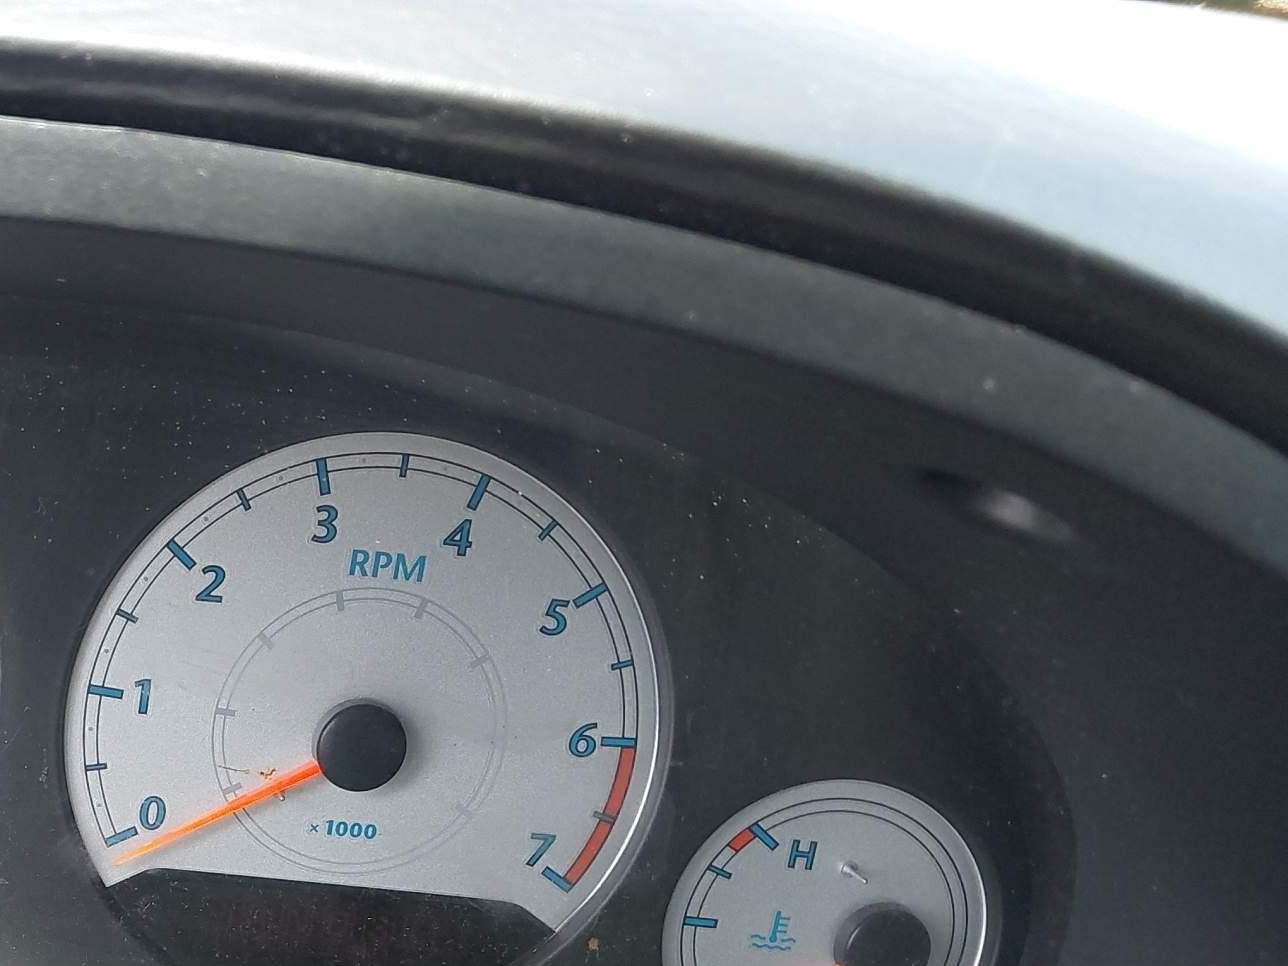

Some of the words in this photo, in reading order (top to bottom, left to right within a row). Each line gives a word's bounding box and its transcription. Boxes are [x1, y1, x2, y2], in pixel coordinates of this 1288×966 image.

[313, 504, 338, 544] 3
[443, 518, 472, 556] 4
[349, 549, 427, 582] RPM
[196, 565, 226, 602] 2
[540, 599, 568, 635] 5
[135, 679, 152, 714] 1
[569, 723, 598, 758] 6
[140, 796, 165, 831] 0
[326, 819, 377, 839] 1000
[524, 833, 555, 866] 7
[788, 840, 817, 869] H
